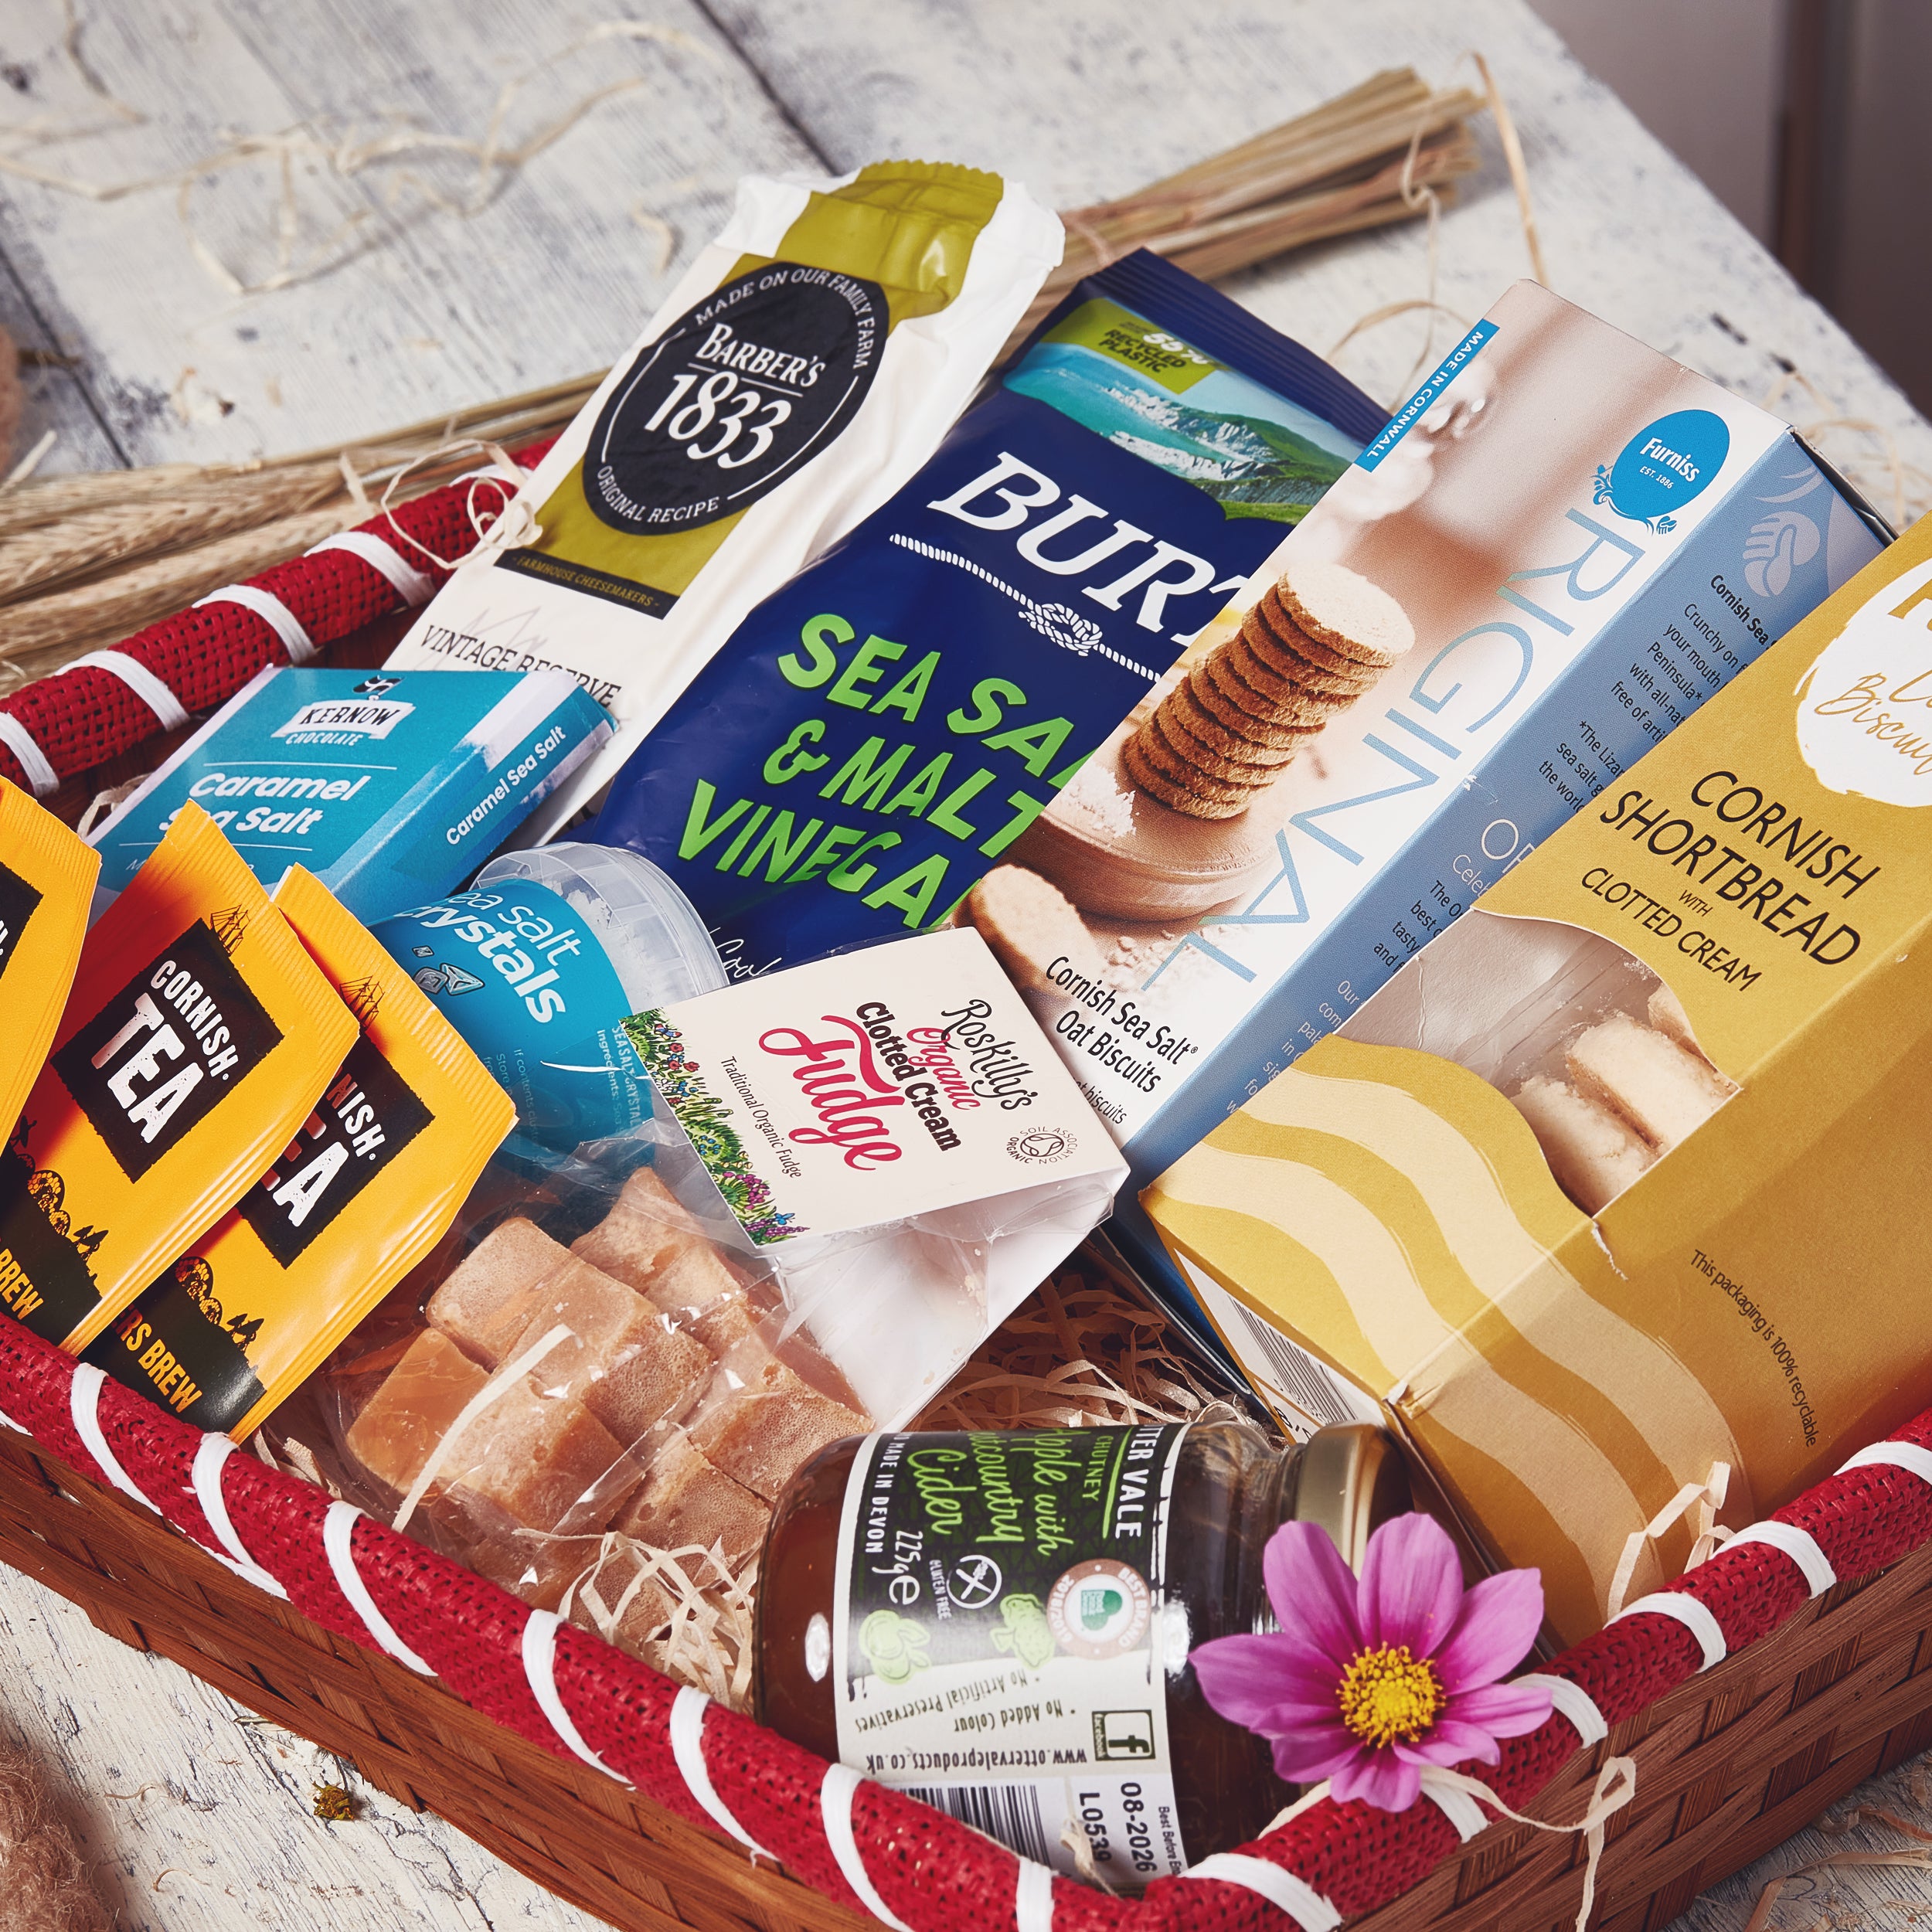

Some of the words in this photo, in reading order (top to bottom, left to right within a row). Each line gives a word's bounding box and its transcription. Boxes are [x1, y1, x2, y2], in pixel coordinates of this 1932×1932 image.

[695, 281, 755, 326] MADE
[759, 270, 788, 291] ON
[790, 267, 832, 286] OUR
[825, 273, 873, 317] FAMILY
[852, 316, 876, 370] FARM
[1097, 338, 1170, 373] PLASTIC
[1104, 328, 1188, 369] RECYCLED
[1445, 331, 1485, 372] MADE
[1430, 367, 1450, 388] IN
[644, 370, 792, 469] 1833
[1366, 387, 1433, 458] CORNWALL
[1638, 465, 1657, 481] EST.
[1655, 473, 1675, 490] 1886
[1639, 437, 1700, 485] Furniss
[597, 465, 645, 524] ORIGINAL
[647, 495, 719, 524] RECIPE
[574, 574, 655, 607] CHEESEMAKERS
[1710, 574, 1750, 623] Cornish
[1747, 617, 1770, 645] Sea
[420, 624, 518, 672] VINTAGE
[1662, 623, 1692, 653] your
[1686, 648, 1722, 689] mouth
[1684, 603, 1726, 654] Crunchy
[1723, 649, 1740, 669] on
[777, 614, 941, 723] SEA
[1629, 662, 1655, 692] with
[298, 704, 402, 726] KERNOW
[1611, 680, 1634, 709] free
[1631, 706, 1650, 722] of
[285, 731, 363, 747] CHOCOLATE
[763, 719, 831, 784] &
[445, 784, 510, 845] Caramel
[507, 756, 539, 786] Sea
[536, 724, 566, 760] Salt
[1539, 760, 1559, 785] the
[1556, 743, 1578, 767] sea
[1574, 763, 1598, 787] salt
[189, 772, 372, 801] Caramel
[235, 806, 324, 835] Salt
[1690, 770, 1882, 900] CORNISH
[678, 779, 981, 934] VINEGA
[1599, 790, 1862, 965] SHORTBREAD
[1430, 879, 1451, 907] The
[1678, 889, 1714, 918] WITH
[497, 905, 582, 967] salt
[1410, 900, 1437, 931] best
[1580, 866, 1683, 938] CLOTTED
[1677, 930, 1764, 992] CREAM
[1373, 942, 1400, 968] and
[1391, 920, 1420, 954] tasty
[1045, 956, 1117, 1016] Cornish
[1111, 1002, 1151, 1040] Sea
[1337, 980, 1360, 1005] Our
[90, 992, 204, 1144] TEA
[513, 1049, 524, 1057] If
[940, 998, 1032, 1111] Roskilly's
[1055, 1010, 1095, 1047] Oat
[1087, 1032, 1162, 1093] Biscuits
[1281, 1038, 1295, 1056] in
[496, 1053, 510, 1084] Store
[855, 1002, 929, 1082] Clotted
[904, 1082, 962, 1152] Cream
[906, 1027, 981, 1111] Organic
[758, 1015, 906, 1171] Fudge
[720, 1055, 758, 1111] Traditional
[752, 1109, 784, 1150] Organic
[775, 1148, 802, 1179] Fudge
[1019, 1126, 1048, 1137] SOIL
[1006, 1137, 1033, 1165] ORGANIC
[1690, 1249, 1716, 1277] This
[1709, 1271, 1767, 1333] packaging
[1761, 1324, 1775, 1342] is
[1770, 1336, 1798, 1377] 100%
[1788, 1376, 1820, 1447] recyclable
[138, 1338, 203, 1413] BREW
[879, 1443, 906, 1468] MADE
[1009, 1428, 1091, 1485] Apple
[1082, 1434, 1114, 1502] CHUTNEY
[874, 1474, 895, 1488] IN
[906, 1448, 978, 1535] Cider
[865, 1496, 889, 1553] DEVON
[1114, 1468, 1150, 1539] VALE
[1034, 1494, 1075, 1556] with
[928, 1559, 947, 1595] GLUTEN
[1117, 1566, 1147, 1598] BEST
[934, 1596, 953, 1621] FREE
[1117, 1598, 1148, 1648] BRAND
[946, 1673, 1005, 1709] Artificial
[1010, 1668, 1029, 1687] No
[854, 1692, 944, 1733] Preservatives
[953, 1711, 996, 1733] Colour
[1000, 1702, 1040, 1729] Added
[1046, 1699, 1063, 1718] No
[1094, 1713, 1107, 1759] facebook
[866, 1747, 1088, 1775] www.ottervaleproducts.co.uk
[1120, 1781, 1158, 1873] 08-2026
[1158, 1805, 1173, 1828] Best
[1162, 1830, 1178, 1859] Before
